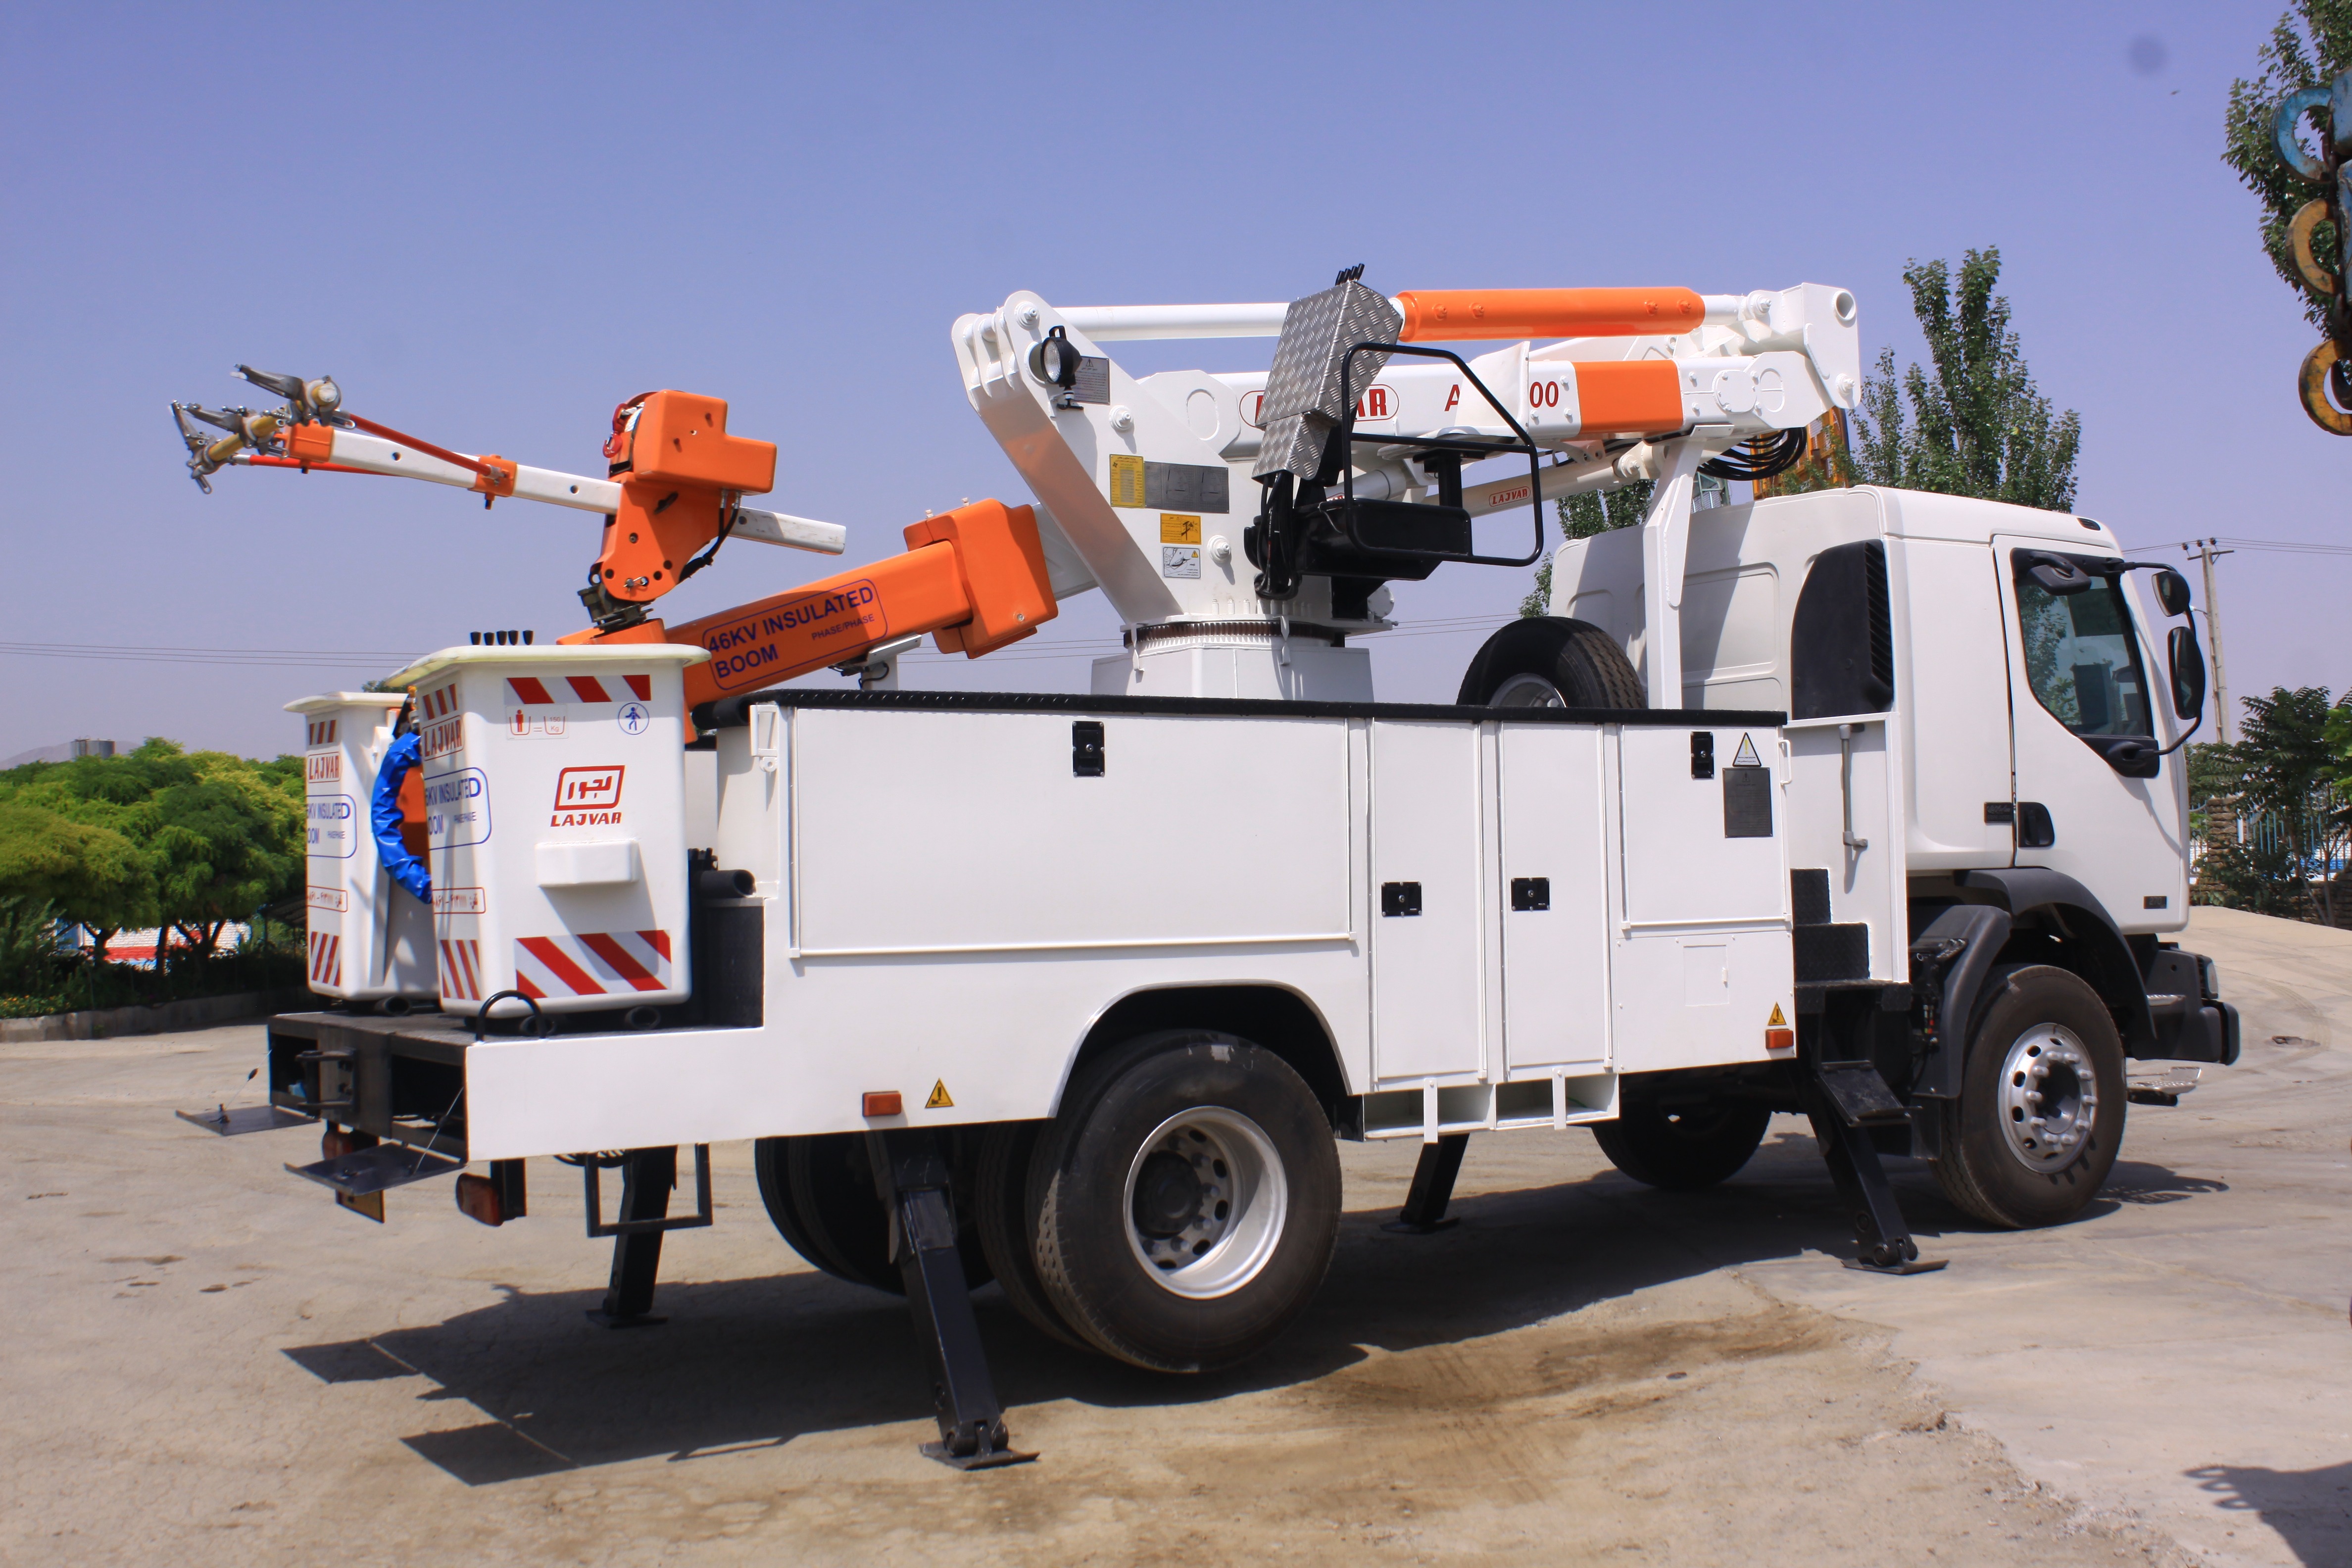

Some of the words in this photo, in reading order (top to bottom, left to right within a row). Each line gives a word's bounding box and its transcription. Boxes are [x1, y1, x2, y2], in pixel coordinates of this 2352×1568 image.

[1492, 489, 1528, 505] LAJVAR
[709, 623, 757, 652] 46KV
[763, 587, 874, 636] INSULATED
[811, 614, 875, 640] PHASE/PHASE
[715, 644, 779, 678] BOOM
[424, 719, 462, 757] LAJVAR
[309, 755, 340, 780] LAJVAR
[550, 812, 623, 828] LAJVAR
